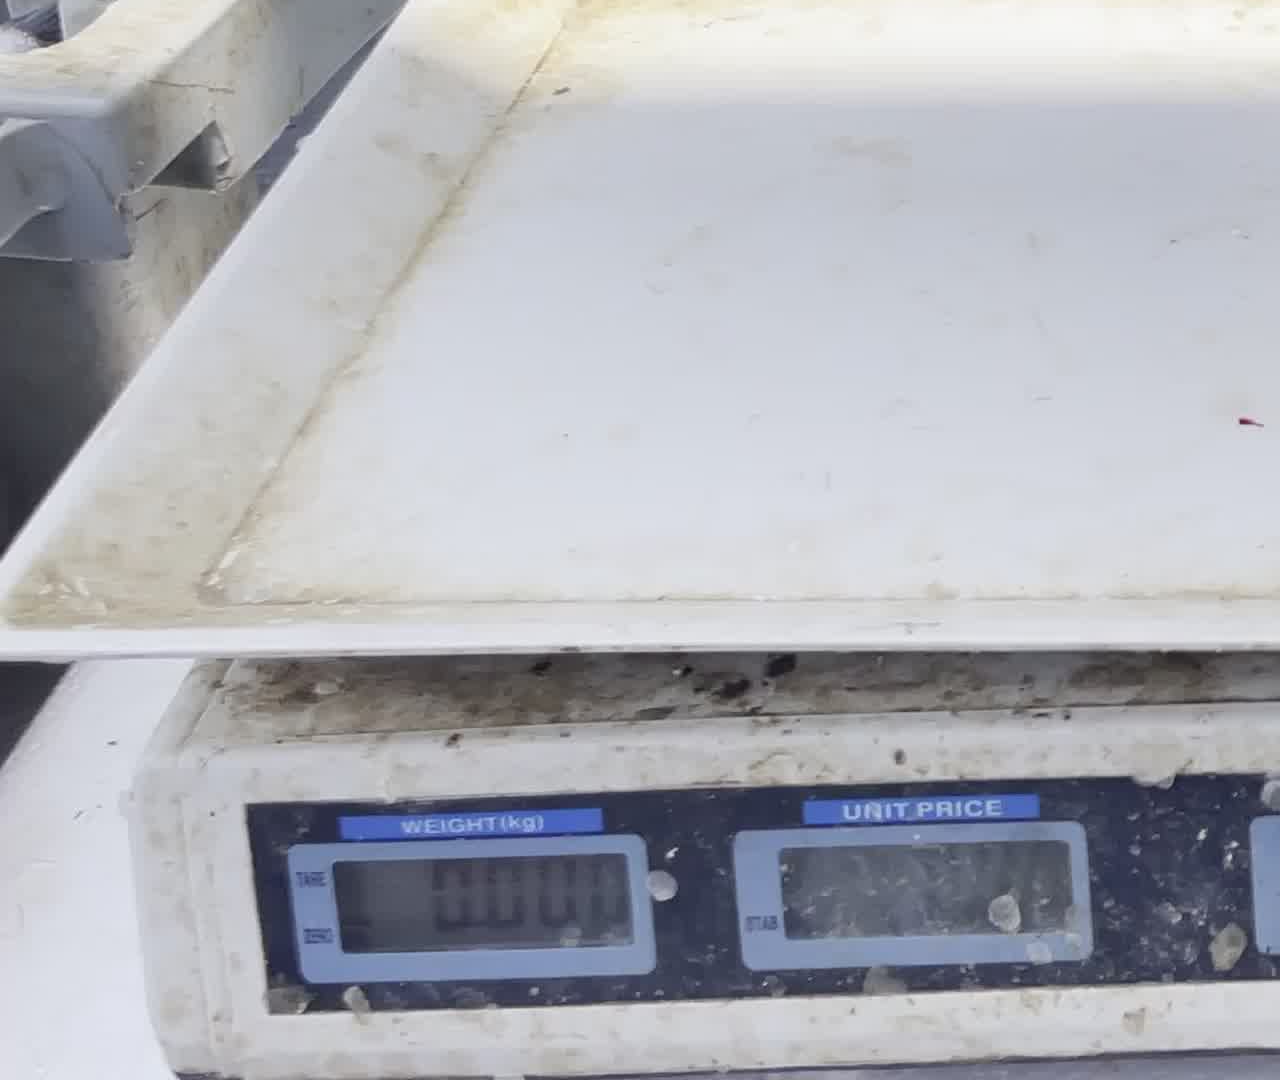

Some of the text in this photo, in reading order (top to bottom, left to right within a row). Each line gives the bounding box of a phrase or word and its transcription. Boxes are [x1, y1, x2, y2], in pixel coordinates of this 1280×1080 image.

[842, 799, 1003, 820] UNIT PRICE
[400, 814, 545, 835] WEIGHT(kg)
